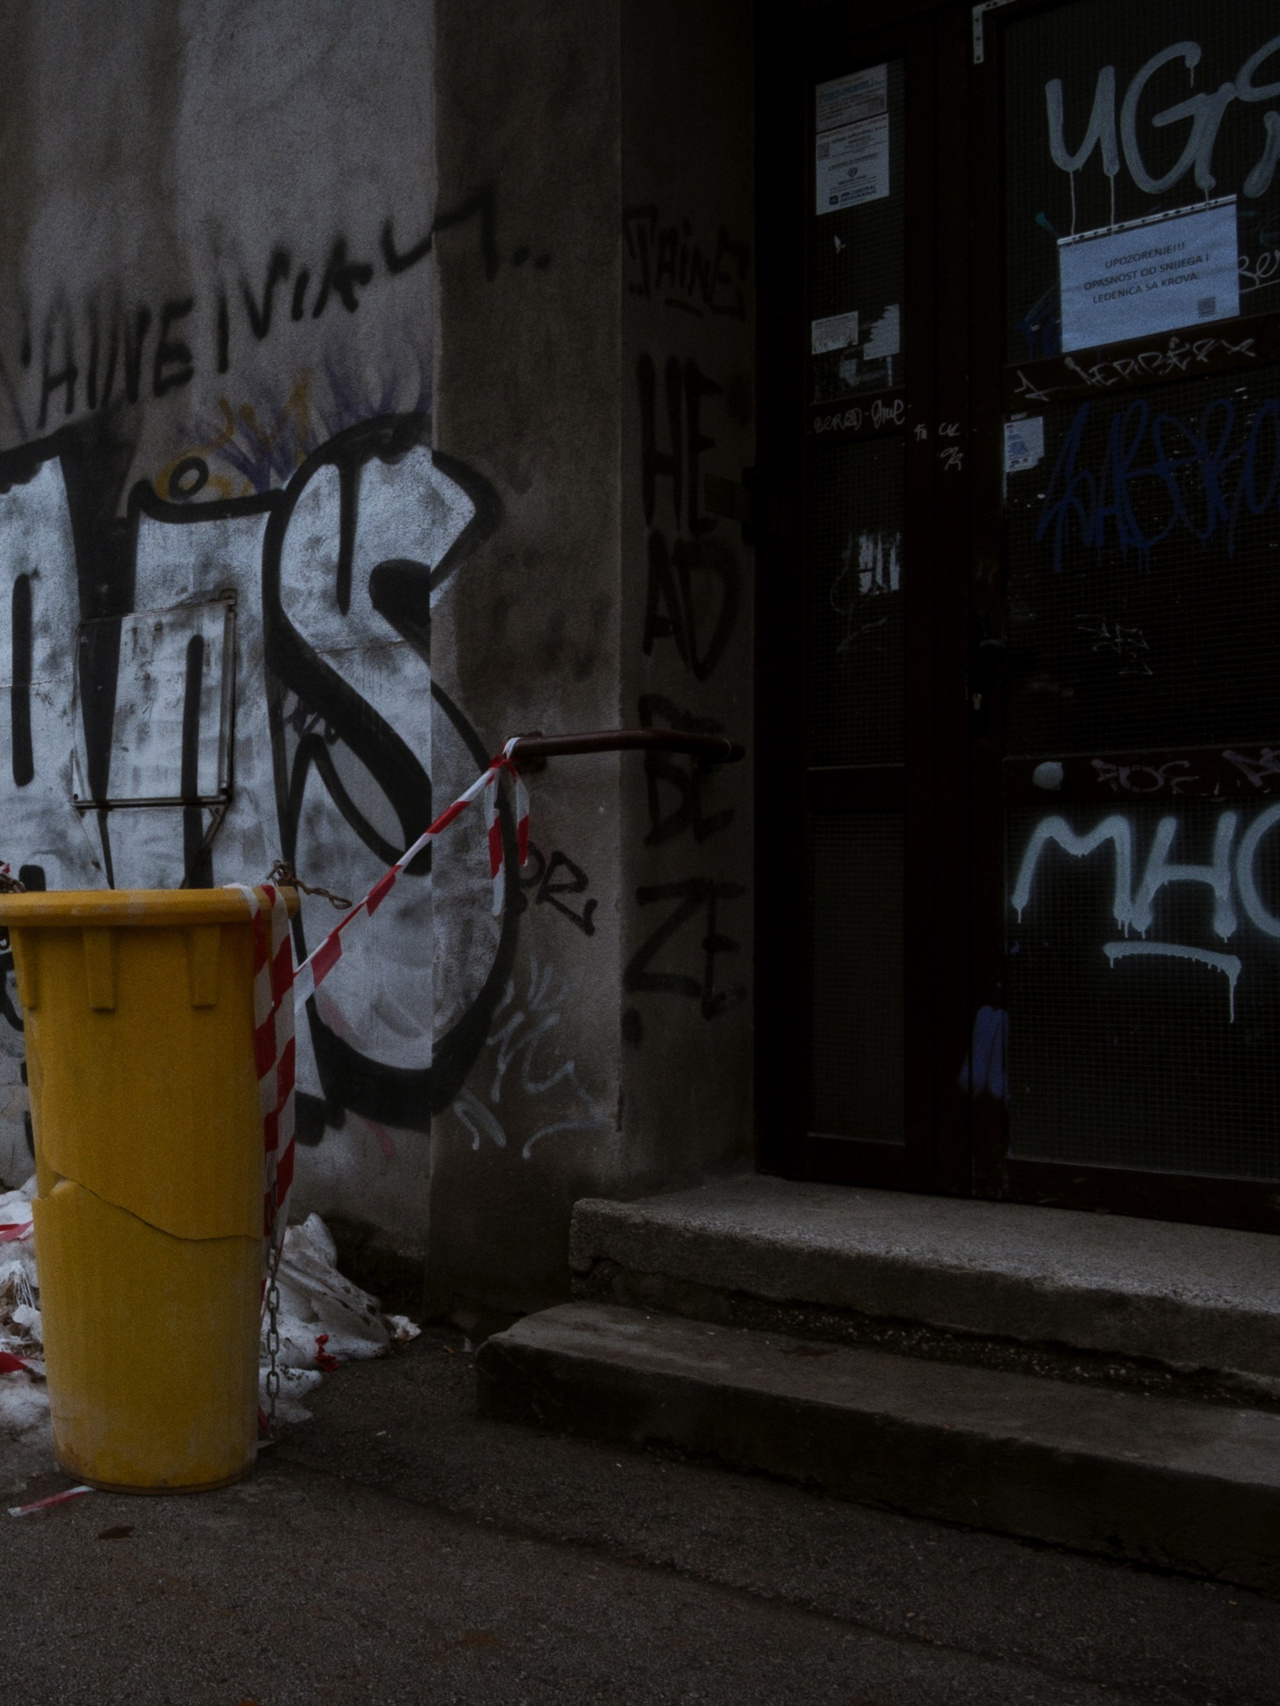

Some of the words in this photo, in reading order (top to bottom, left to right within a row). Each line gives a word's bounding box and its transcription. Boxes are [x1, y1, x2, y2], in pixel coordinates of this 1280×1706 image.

[1105, 241, 1185, 269] UPOZORENJE!!!
[1083, 270, 1138, 291] OPASNOST
[1140, 266, 1157, 277] OD
[1159, 256, 1203, 273] SNIJEGA
[1092, 285, 1143, 304] LEDENICA
[1145, 281, 1159, 292] SA
